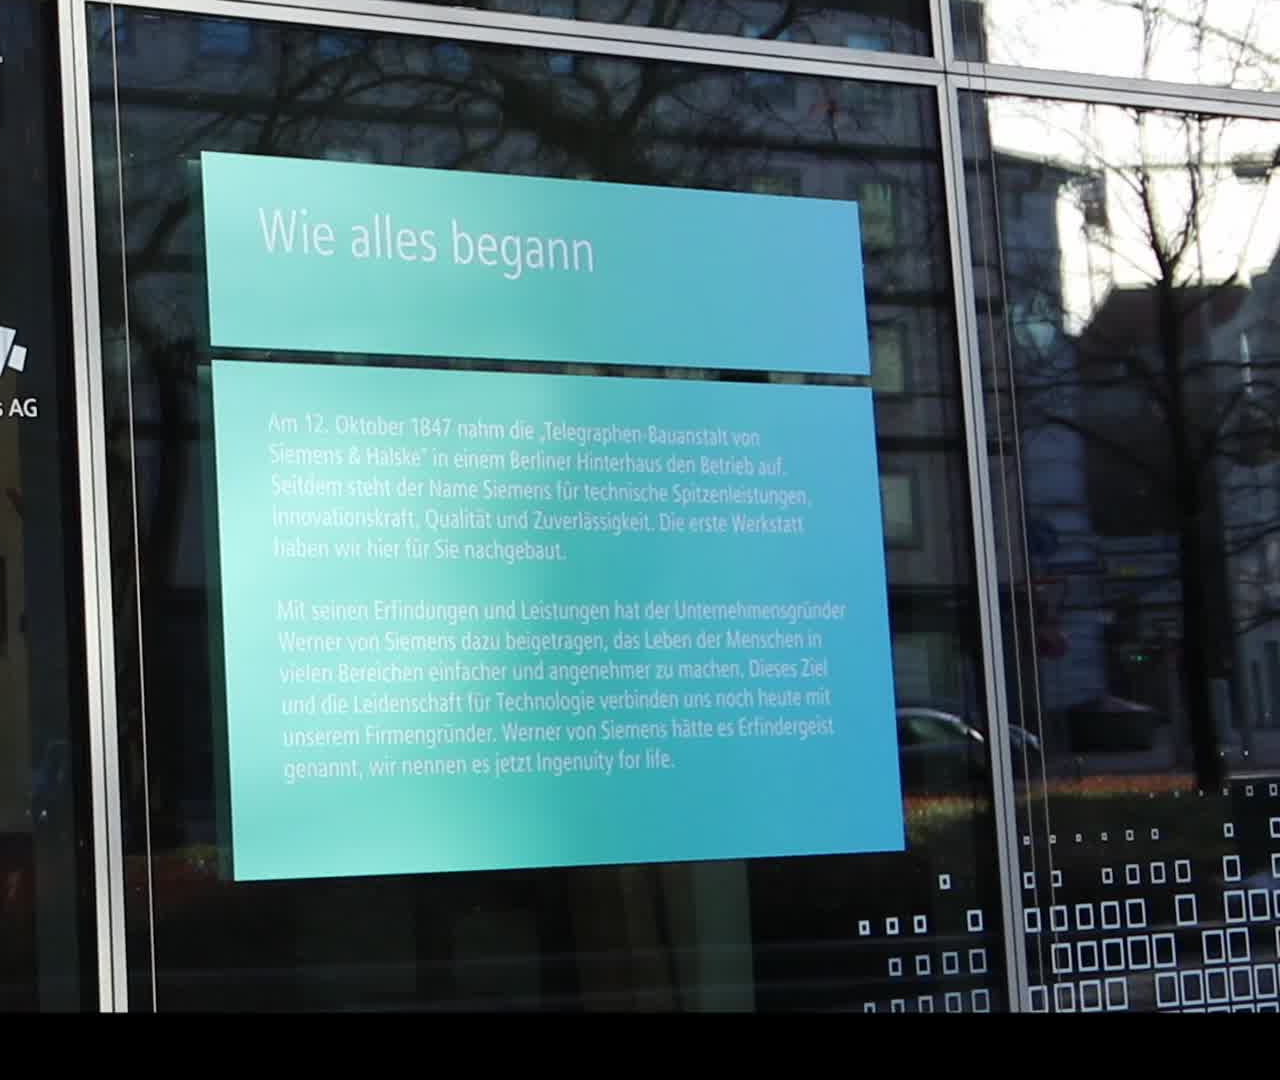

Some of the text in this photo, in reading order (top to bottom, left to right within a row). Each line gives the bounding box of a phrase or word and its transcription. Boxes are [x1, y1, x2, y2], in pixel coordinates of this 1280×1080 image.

[257, 206, 595, 280] Wie alles begann
[8, 397, 38, 418] AG
[268, 413, 297, 433] Am
[305, 413, 329, 433] 12.
[335, 415, 405, 436] Oktober
[413, 417, 452, 438] 1847
[457, 420, 505, 440] nahm
[509, 420, 534, 441] die
[733, 429, 760, 447] von
[269, 443, 342, 465] Siemens
[348, 445, 361, 465] &
[431, 448, 449, 468] in
[453, 449, 505, 469] einem
[509, 449, 572, 471] Berliner
[576, 452, 663, 473] Hinterhaus
[666, 455, 696, 473] den
[700, 455, 754, 476] Betrieb
[757, 456, 788, 476] auf.
[271, 474, 342, 497] Seitdem
[347, 476, 392, 497] steht
[396, 477, 425, 497] der
[429, 478, 479, 499] Name
[483, 480, 553, 501] Siemens
[556, 481, 580, 502] für
[584, 482, 668, 503] technische
[425, 507, 493, 531] Qualität
[496, 510, 528, 530] und
[658, 512, 685, 532] Die
[688, 515, 728, 533] erste
[731, 514, 806, 535] Werkstatt
[273, 536, 567, 565] haben wir hier für Sie nachgebaut.
[277, 599, 847, 625] Mit seinen Erfindungen und Leistungen hat der Unternehmensgründer
[278, 631, 348, 651] Werner
[350, 634, 380, 651] von
[384, 631, 457, 651] Siemens
[461, 631, 500, 651] dazu
[613, 630, 640, 650] das
[644, 630, 691, 650] Leben
[695, 630, 723, 649] der
[726, 629, 803, 649] Menschen
[807, 629, 823, 649] in
[279, 657, 829, 685] vielen Bereichen einfacher und angenehmer zu machen. Dieses Ziel
[281, 687, 832, 716] und die Leidenschaft für Technologie verbinden uns noch heute mit
[282, 728, 360, 748] unserem
[502, 721, 561, 743] Werner
[565, 724, 597, 741] von
[600, 719, 668, 741] Siemens
[671, 717, 713, 738] hätte
[716, 721, 735, 738] es
[738, 714, 834, 741] Erfindergeist
[284, 747, 676, 784] genannt, wir nennen es jetzt Ingenuity for life.
